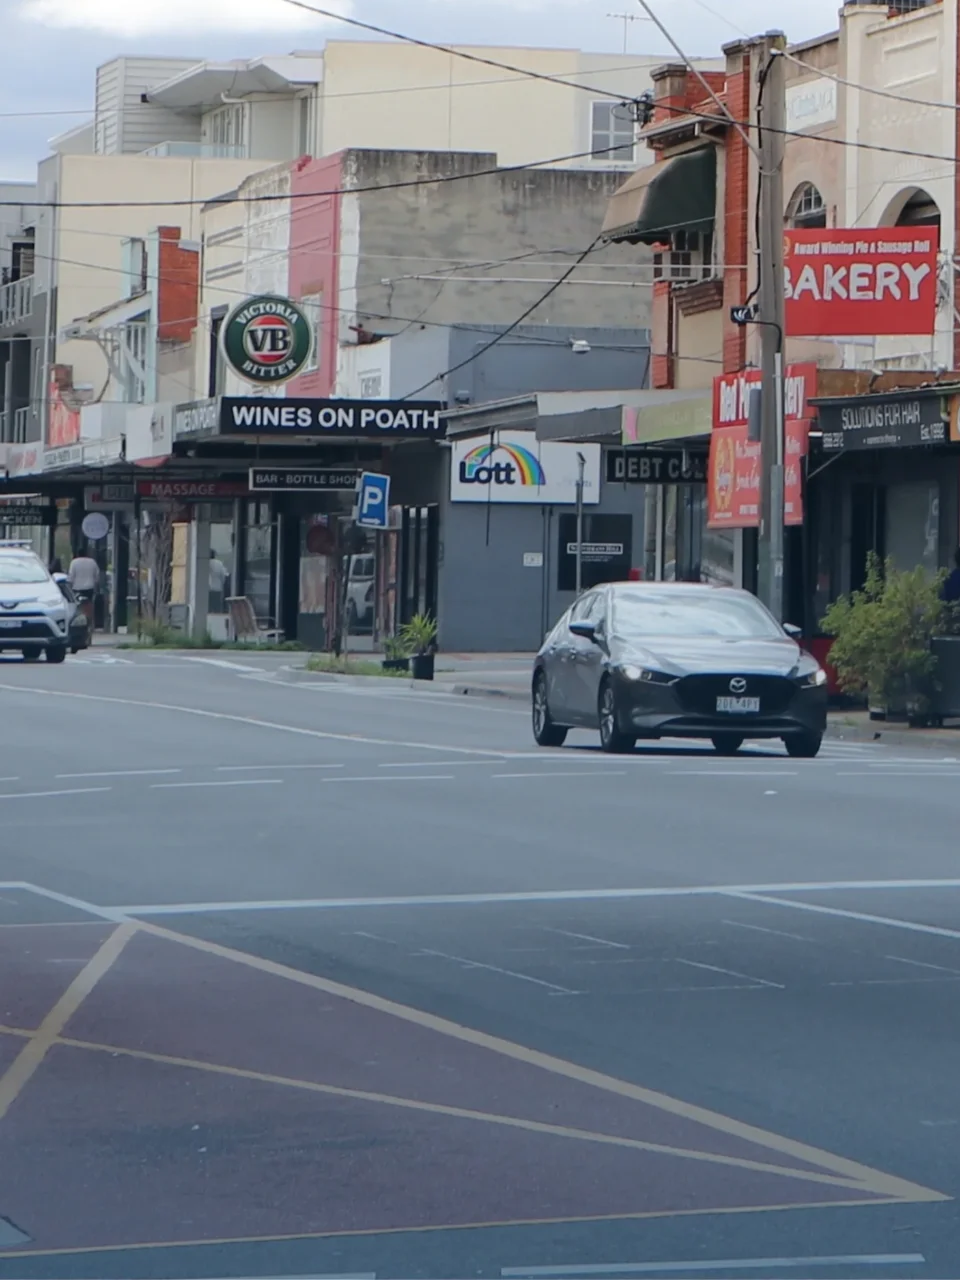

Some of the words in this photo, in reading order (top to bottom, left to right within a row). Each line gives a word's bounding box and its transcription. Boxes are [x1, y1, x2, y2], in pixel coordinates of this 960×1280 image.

[821, 241, 854, 256] Winning
[855, 241, 869, 254] Pie
[877, 240, 913, 254] Sausage
[235, 302, 299, 325] VICTORIA
[247, 326, 289, 353] VB
[241, 358, 297, 377] BITTER
[232, 405, 312, 428] WINES
[318, 407, 354, 429] ON
[360, 408, 440, 430] POATH
[842, 404, 884, 430] SOLUTIONS
[884, 403, 901, 426] FOR
[901, 401, 921, 425] HAIR
[255, 473, 278, 484] BAR
[286, 474, 326, 484] BOTTLE
[329, 475, 357, 485] SHOP
[459, 461, 516, 485] Lott
[614, 457, 664, 478] DEBT
[150, 483, 217, 495] MASSAGE
[362, 485, 383, 515] P
